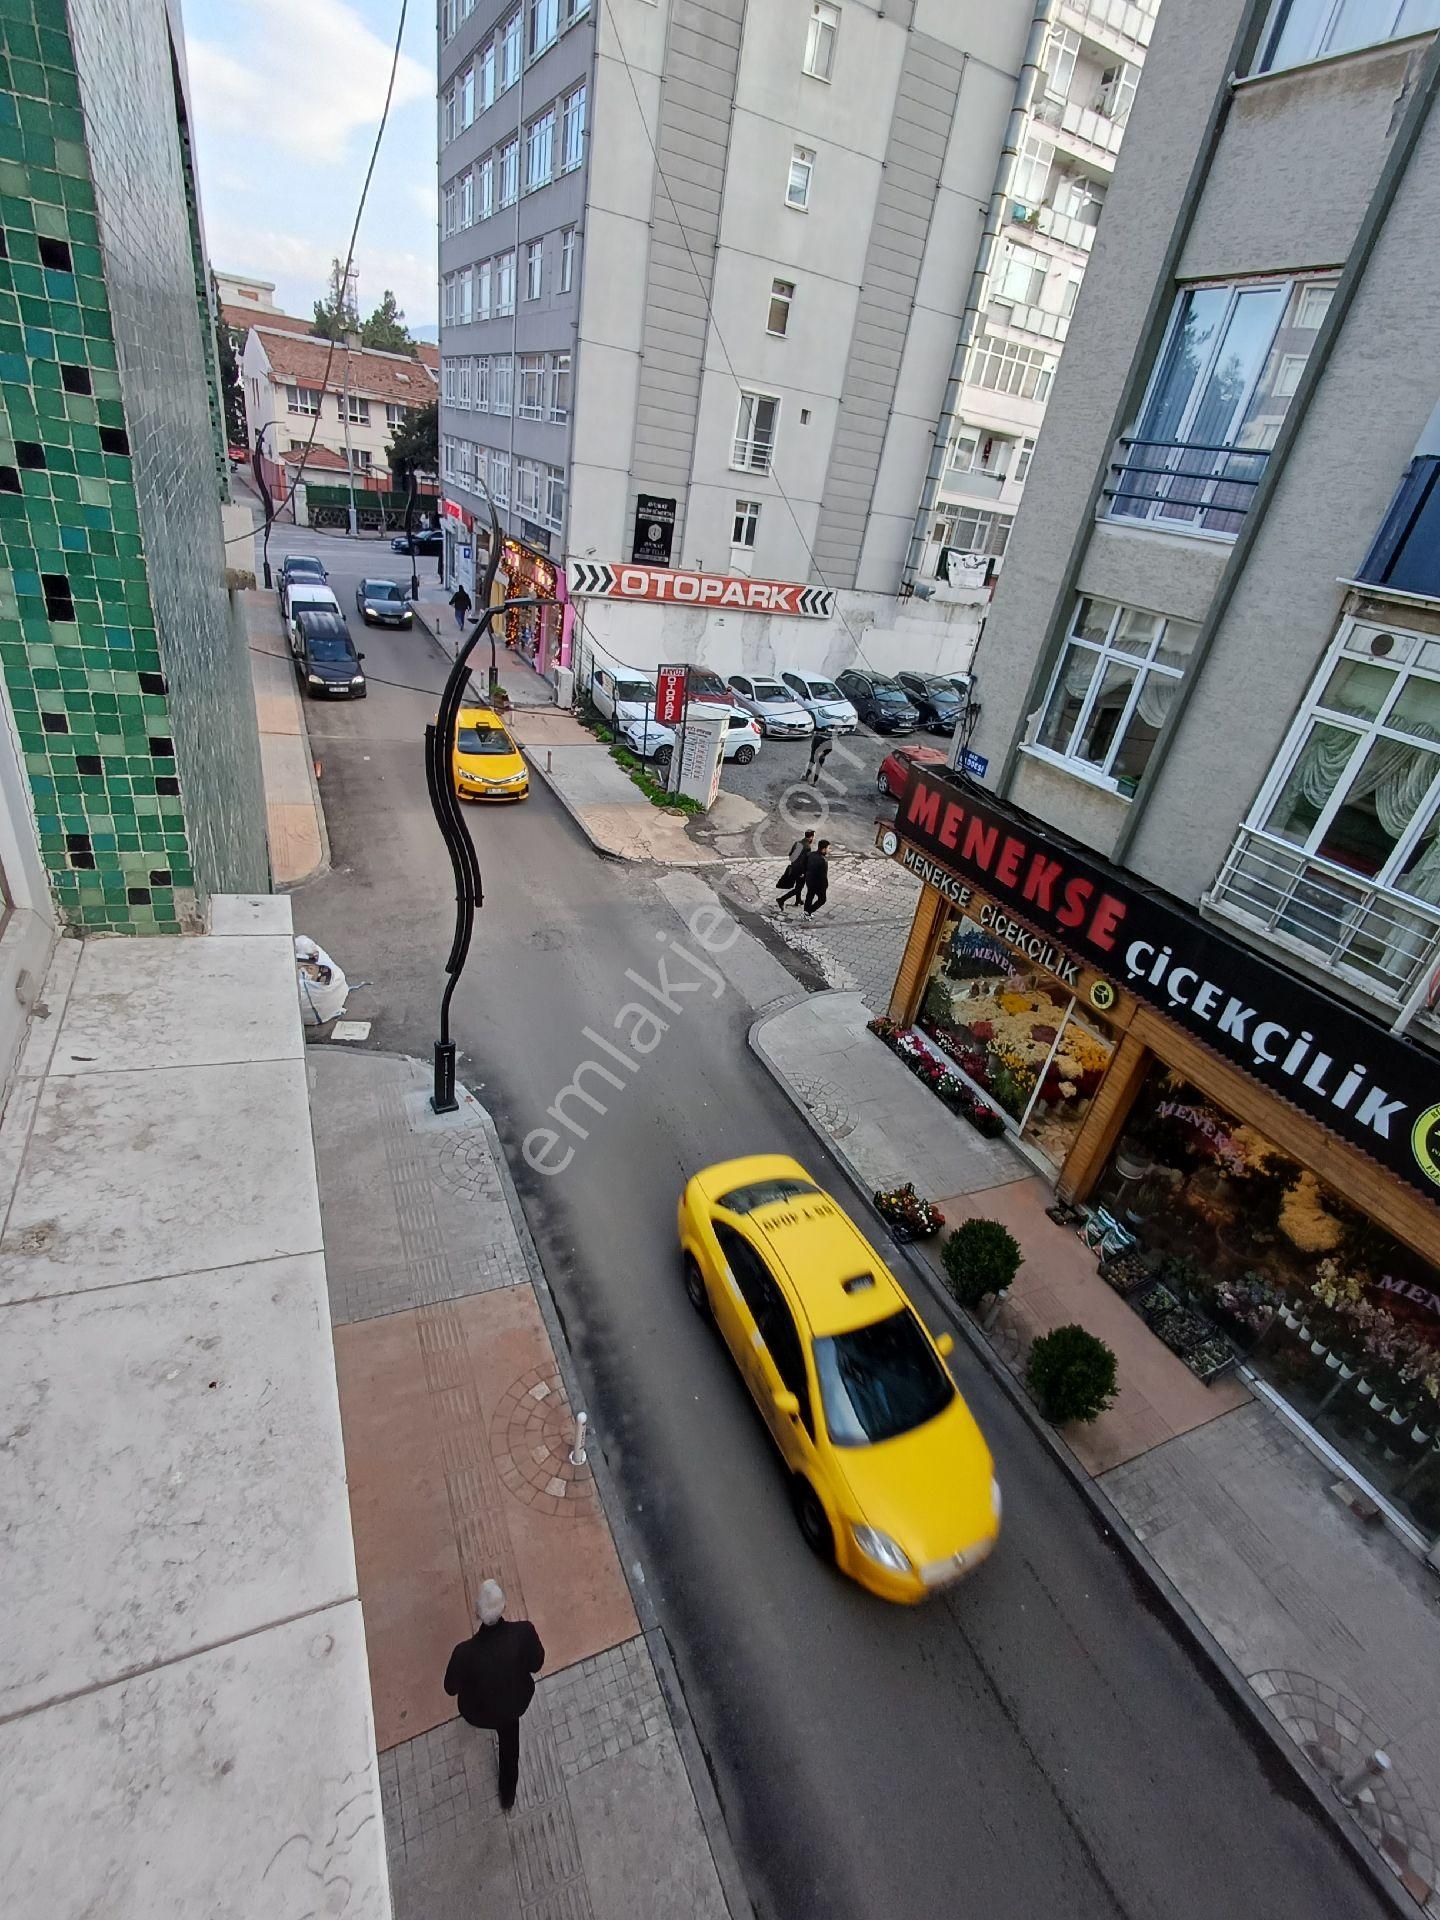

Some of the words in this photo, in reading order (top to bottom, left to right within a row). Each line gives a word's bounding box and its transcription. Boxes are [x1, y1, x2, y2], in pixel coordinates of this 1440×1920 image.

[621, 570, 796, 611] OTOPARK
[663, 676, 677, 721] OTOPARK
[907, 783, 1127, 952] MENEKŞE
[1125, 940, 1408, 1139] ÇİÇEKÇİLİK
[980, 904, 1080, 986] ÇİÇEKÇİLİK
